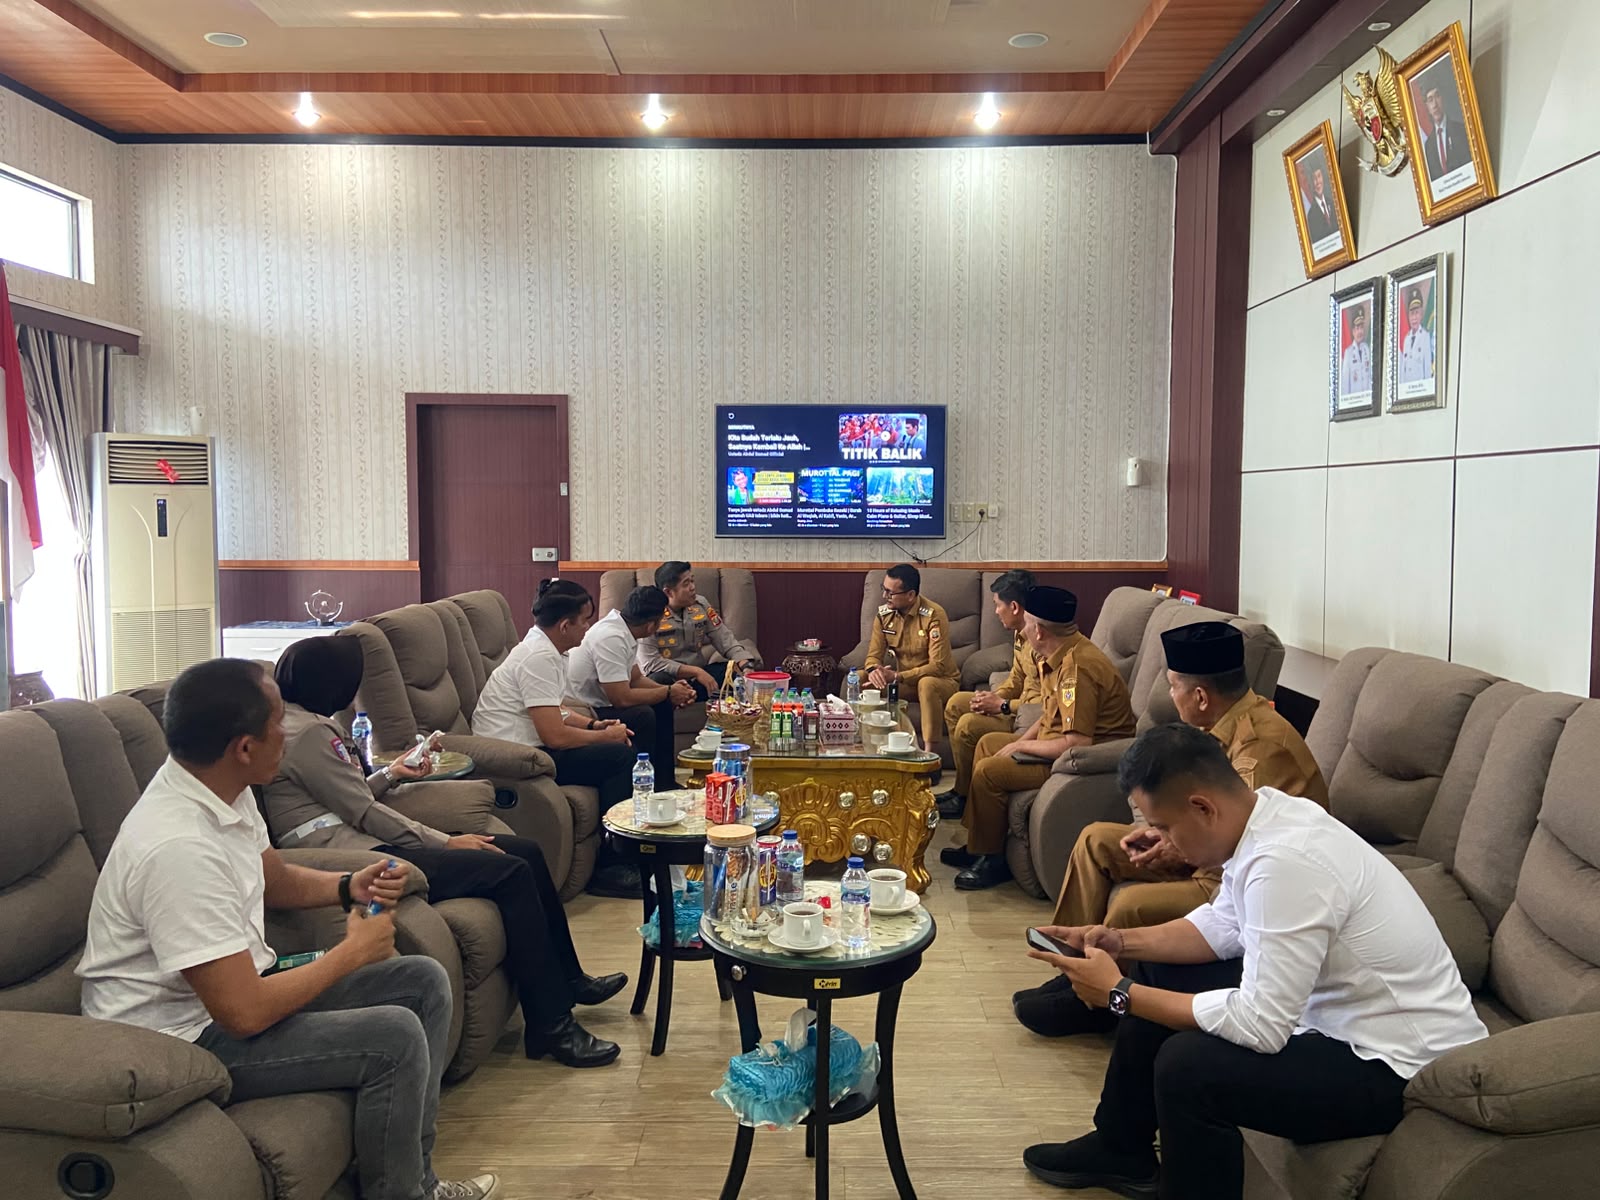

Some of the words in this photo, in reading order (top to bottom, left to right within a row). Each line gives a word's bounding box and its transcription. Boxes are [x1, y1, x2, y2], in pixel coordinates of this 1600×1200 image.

[841, 447, 879, 460] TITIK
[881, 447, 923, 460] BALIK
[801, 469, 841, 477] MUROTTAL
[842, 469, 860, 477] PAGI
